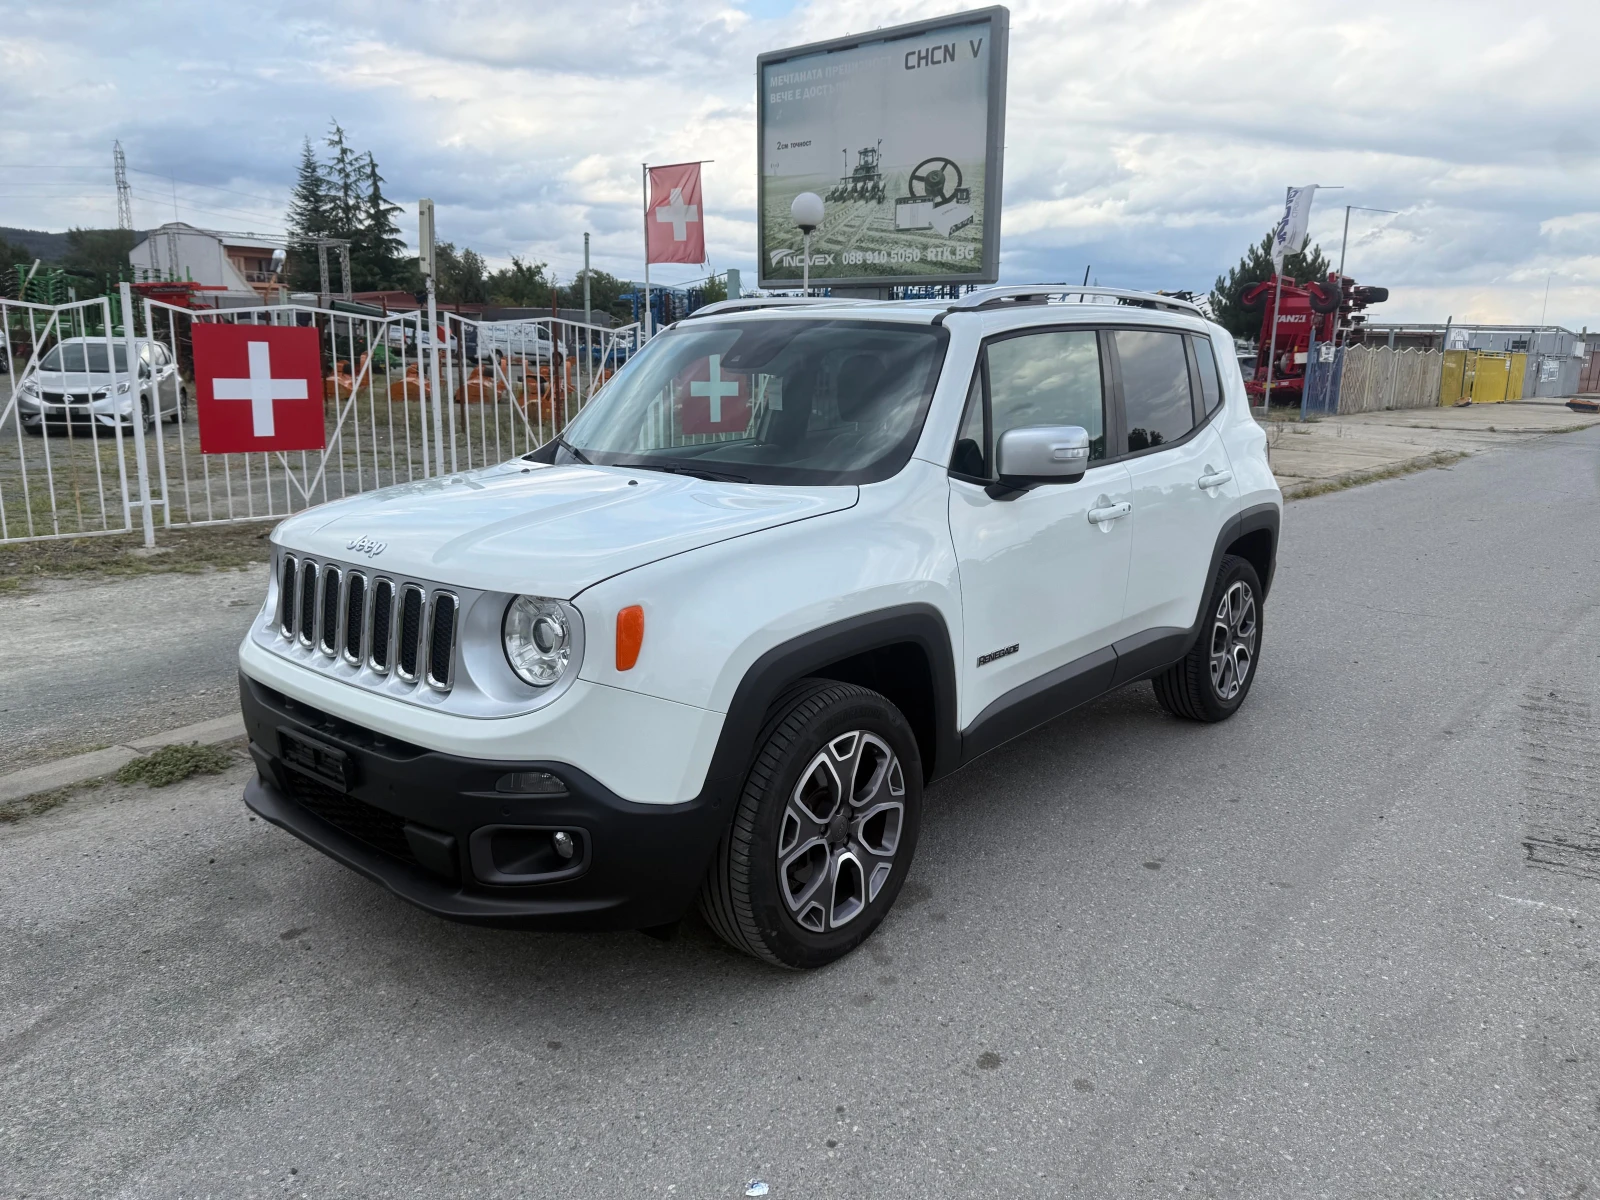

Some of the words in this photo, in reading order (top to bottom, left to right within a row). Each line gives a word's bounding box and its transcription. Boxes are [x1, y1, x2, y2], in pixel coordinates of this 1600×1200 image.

[770, 68, 823, 87] МЕЧТАНАТА
[770, 90, 794, 104] ВЕЧЕ
[796, 88, 802, 100] Е
[776, 141, 789, 150] 2см
[790, 140, 812, 149] точност
[842, 252, 862, 265] 088
[865, 250, 886, 264] 910
[890, 247, 921, 262] 5050
[927, 243, 975, 260] RTK.BG
[346, 534, 388, 558] Jeep
[976, 643, 1020, 668] RENEGADE
